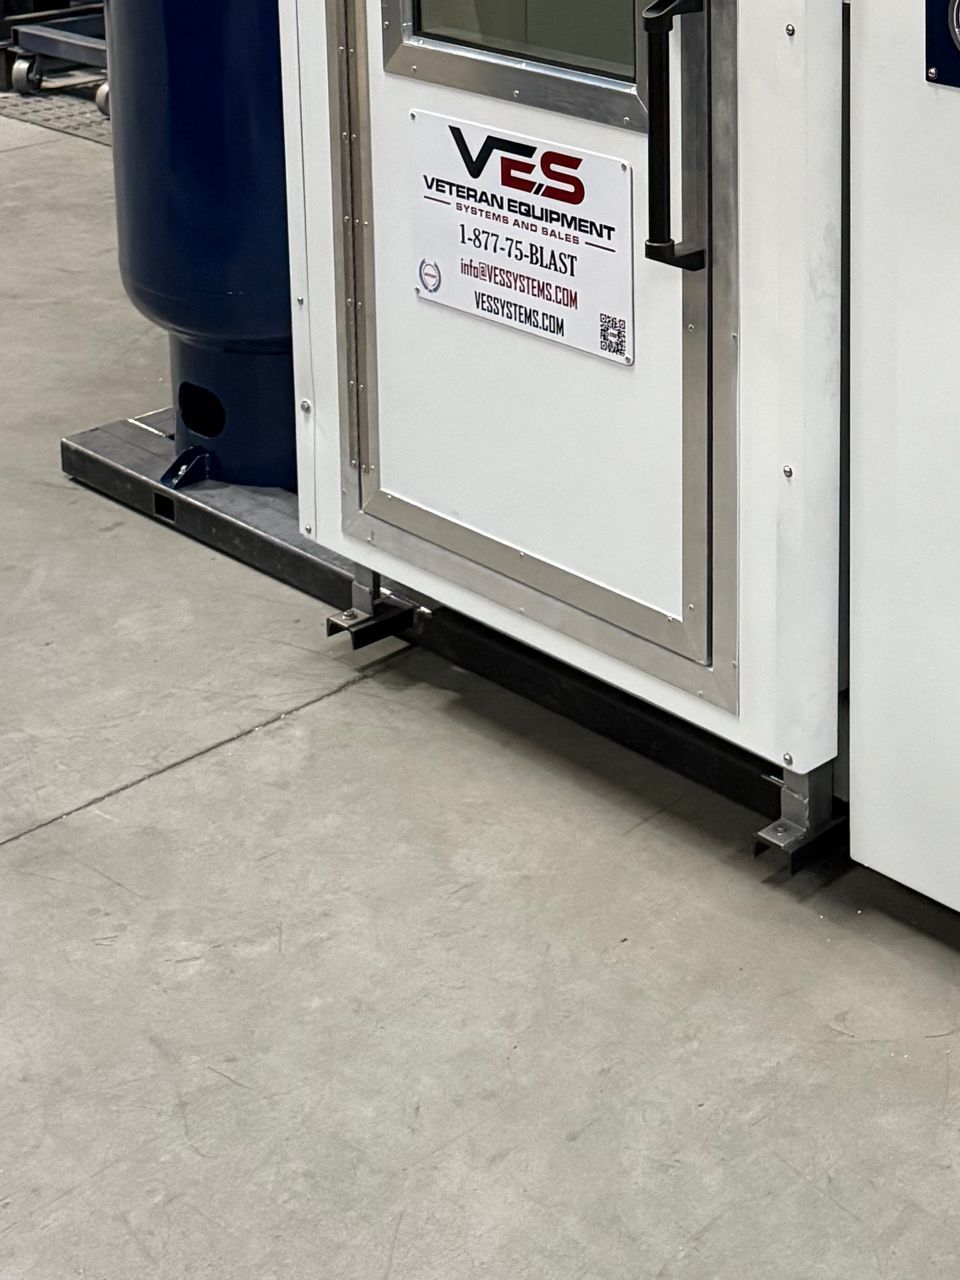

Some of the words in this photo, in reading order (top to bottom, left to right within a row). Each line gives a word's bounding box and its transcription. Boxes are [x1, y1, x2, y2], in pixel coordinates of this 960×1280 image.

[448, 124, 585, 205] VES
[423, 174, 504, 210] VETERAN
[507, 198, 616, 241] EQUIPMENT
[456, 203, 509, 224] SYSTEMS
[513, 216, 538, 233] AND
[542, 227, 580, 245] SALES
[459, 224, 577, 277] 1-877-75-BLAST
[460, 258, 578, 310] info@VESSYSTEMS.COM
[474, 291, 564, 337] VESSYSTEMS.COM
